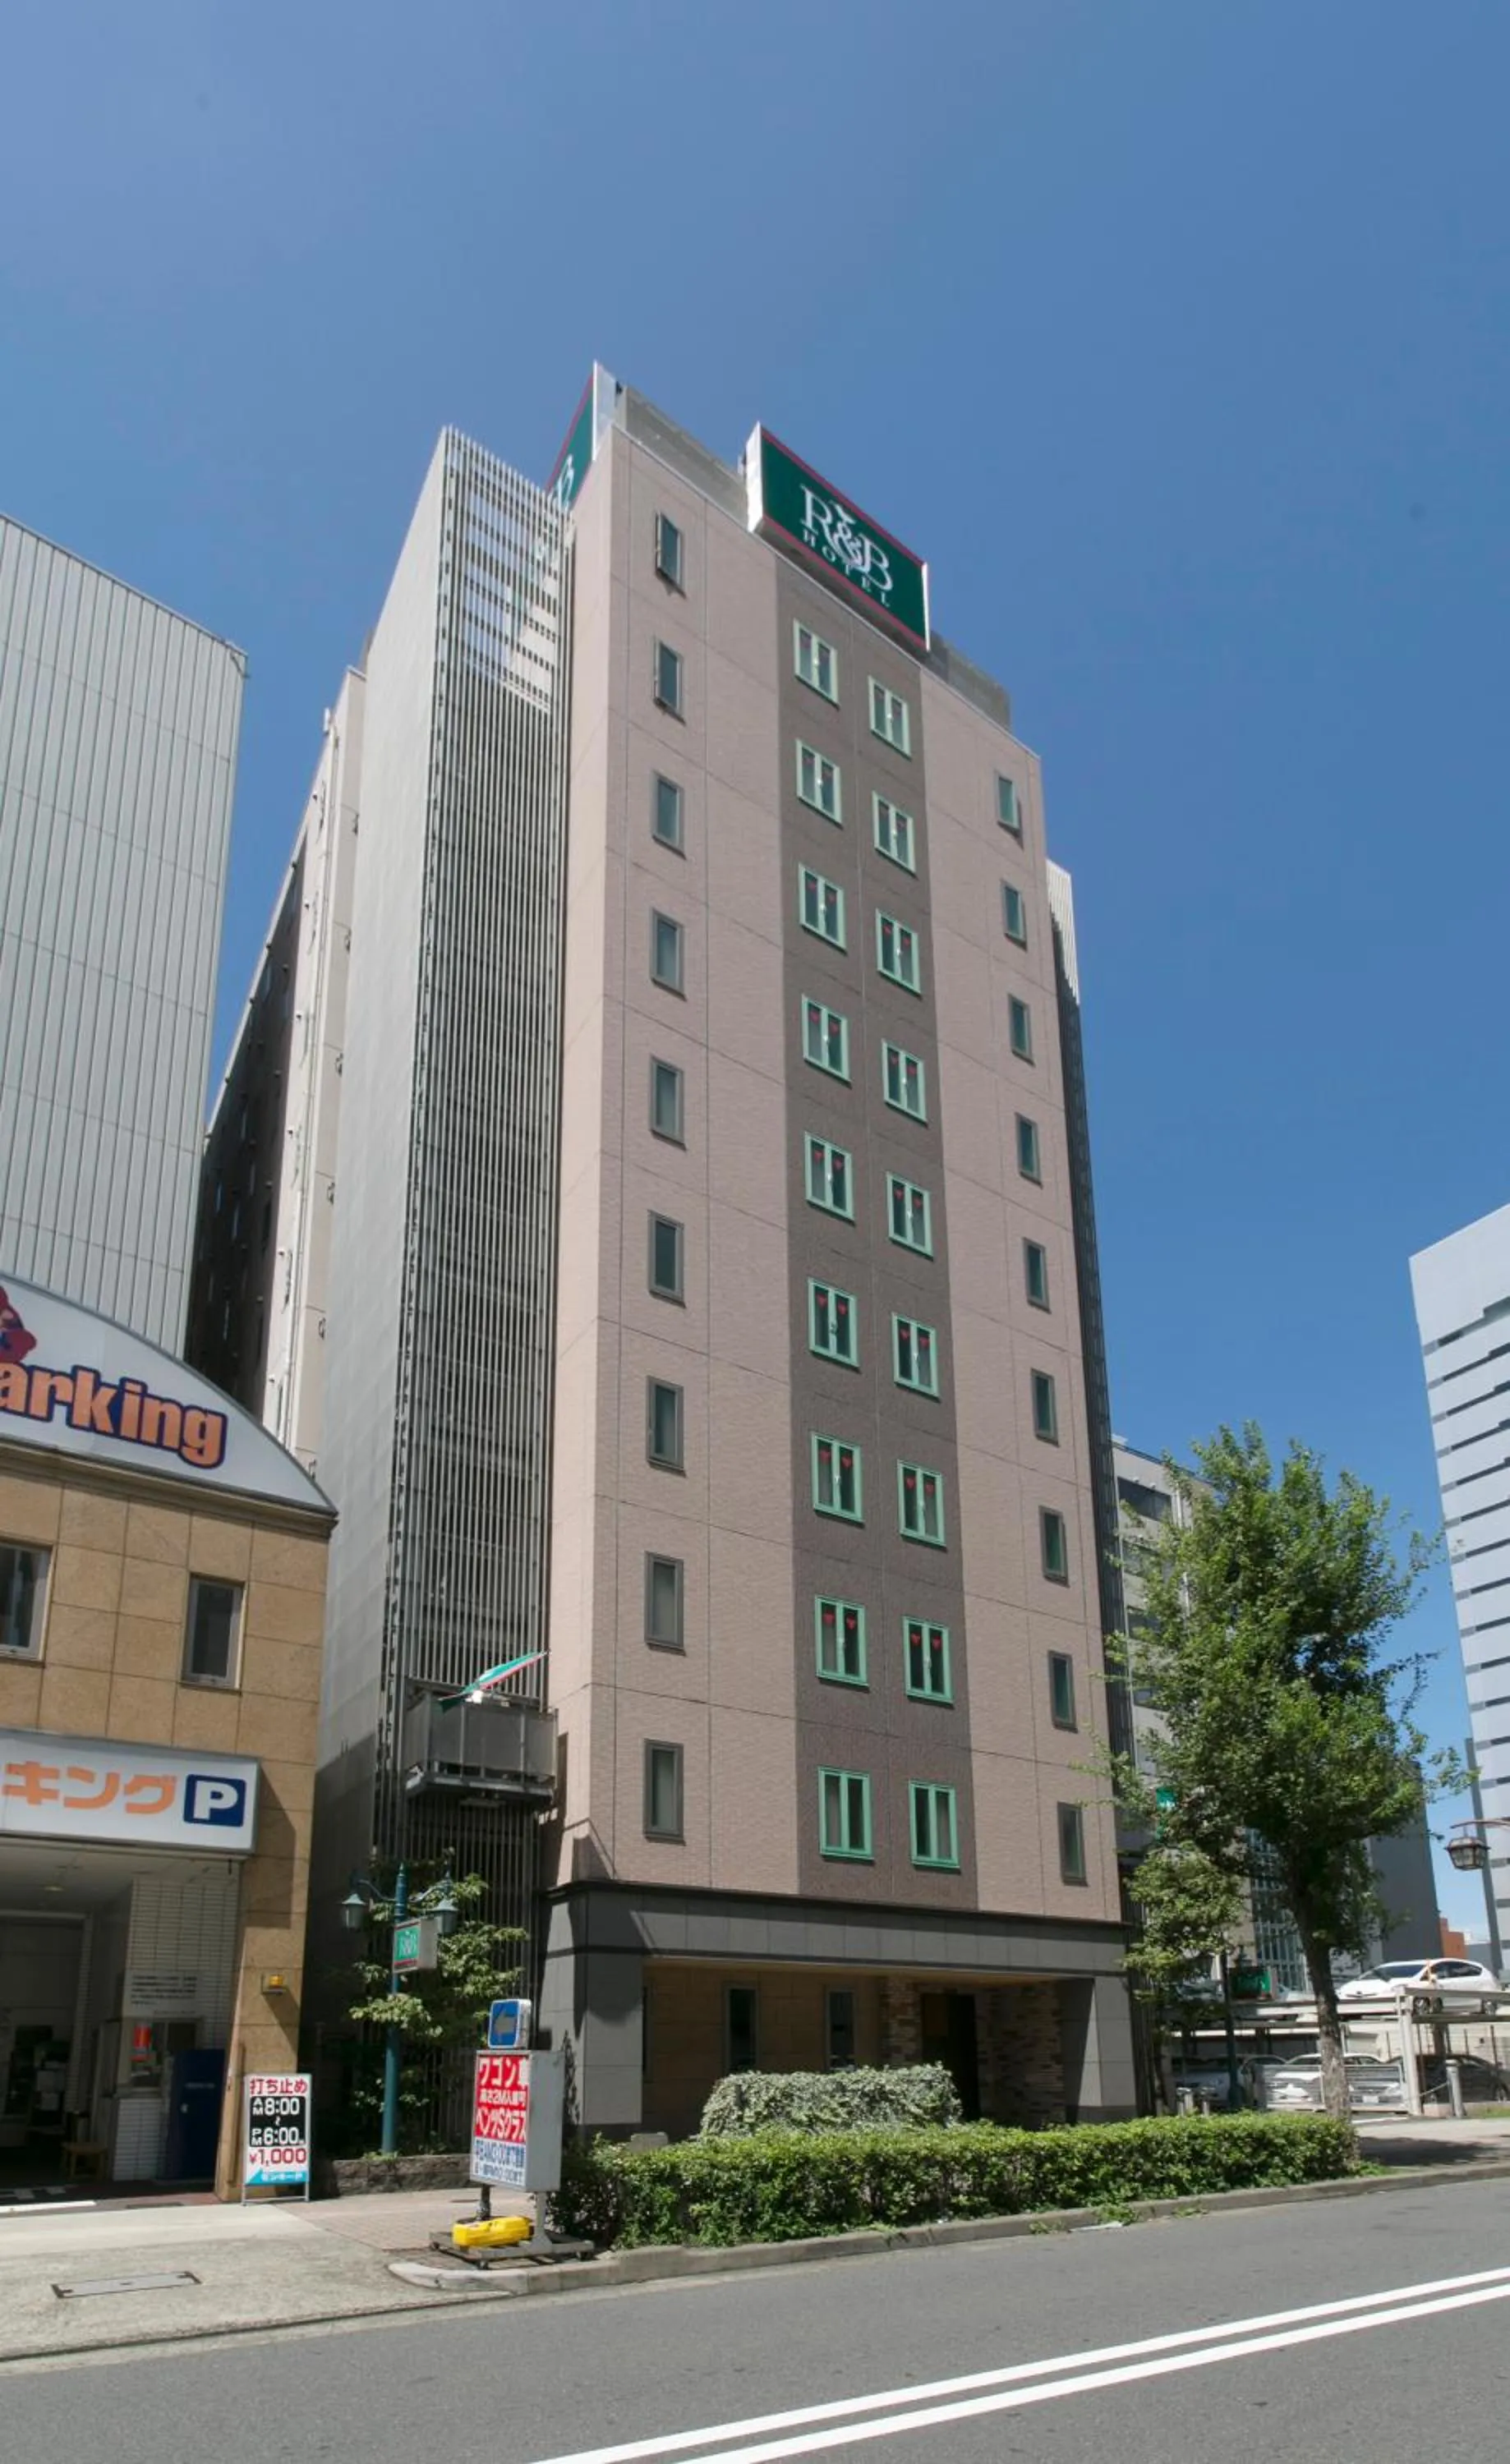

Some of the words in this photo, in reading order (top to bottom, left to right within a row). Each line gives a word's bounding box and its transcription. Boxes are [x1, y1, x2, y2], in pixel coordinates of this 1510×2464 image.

[799, 484, 893, 591] R&B
[803, 529, 891, 608] HOTEL
[2, 1761, 178, 1815] キング
[193, 1779, 239, 1820] P
[250, 2079, 307, 2095] 打ち止め
[265, 2098, 300, 2115] 8:00
[264, 2127, 299, 2145] 6:00
[249, 2148, 307, 2167] ¥1,000
